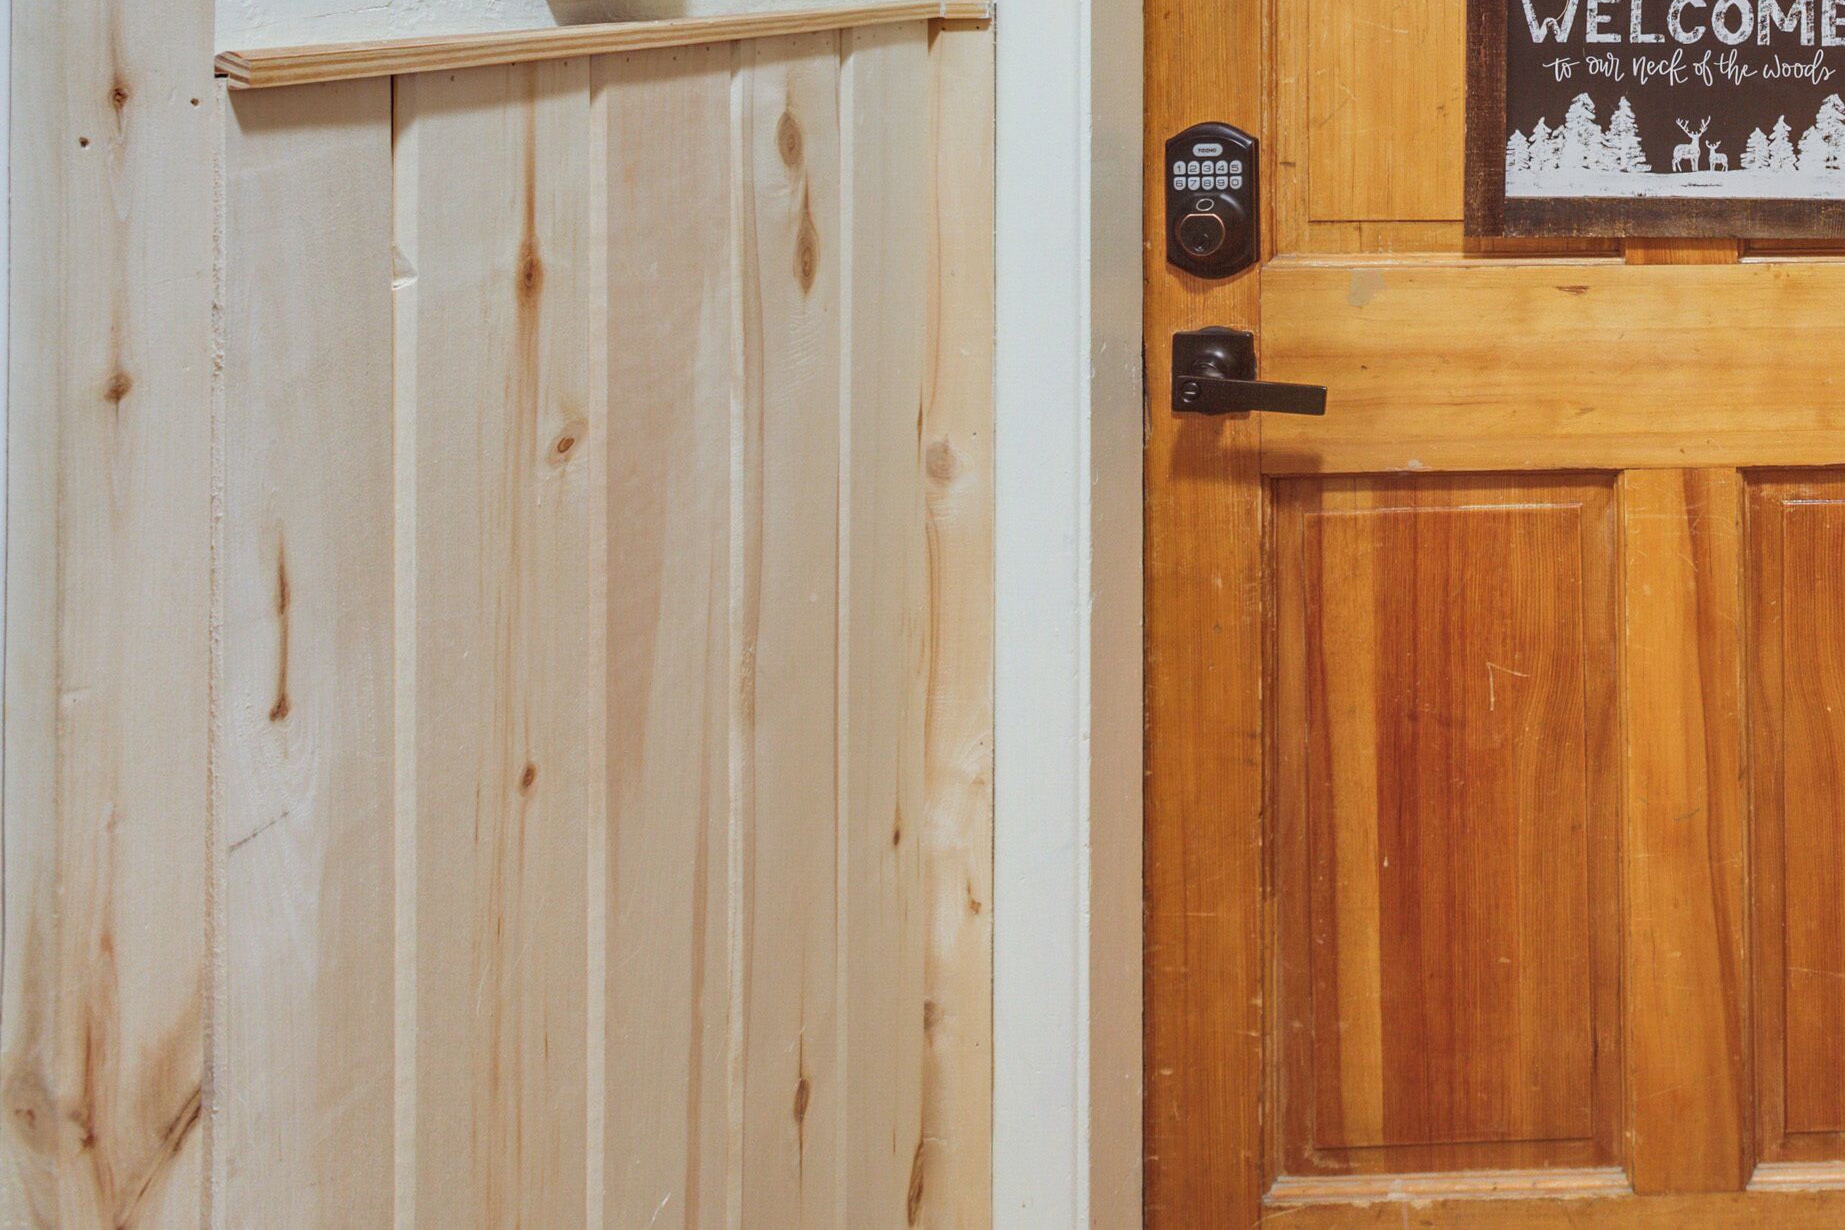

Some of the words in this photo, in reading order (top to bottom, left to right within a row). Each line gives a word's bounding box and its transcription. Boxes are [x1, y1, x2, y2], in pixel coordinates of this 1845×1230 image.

[1542, 57, 1579, 82] to
[1585, 52, 1624, 81] our
[1632, 48, 1688, 86] neck
[1692, 50, 1712, 86] of
[1713, 49, 1757, 85] the
[1762, 50, 1836, 84] woods
